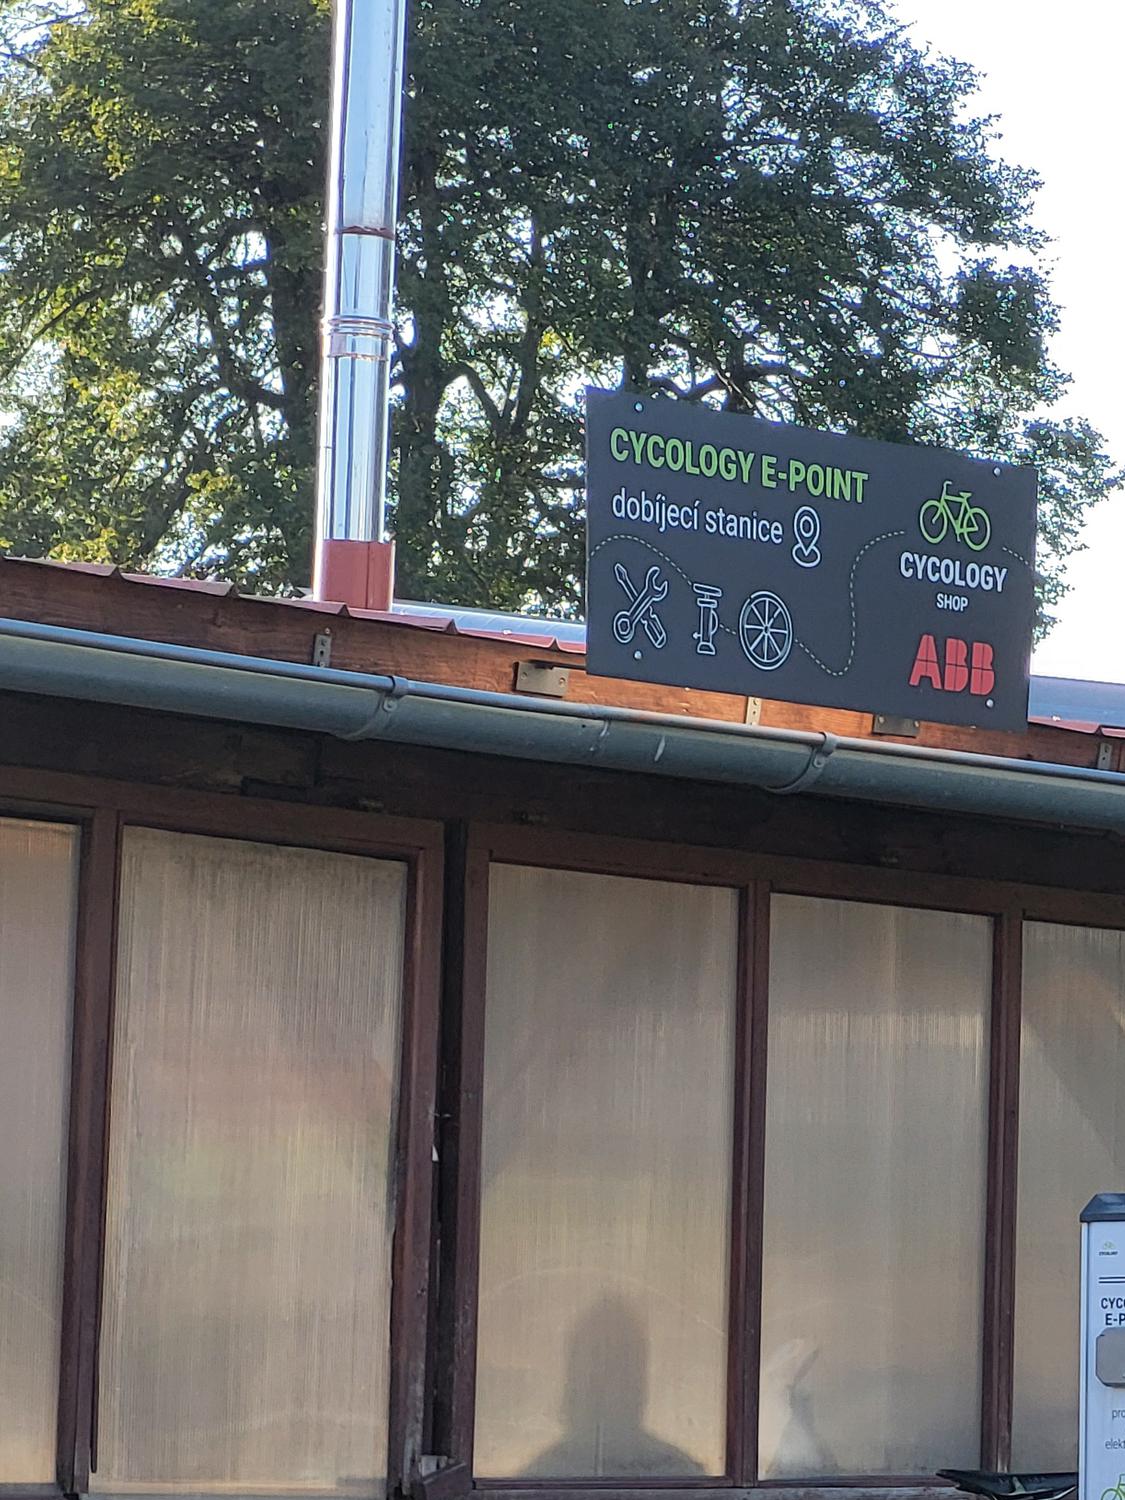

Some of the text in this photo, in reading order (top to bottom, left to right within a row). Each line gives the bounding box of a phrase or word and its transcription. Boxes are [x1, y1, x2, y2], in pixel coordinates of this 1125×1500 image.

[609, 427, 869, 503] CYCOLOGY E-POINT
[612, 487, 784, 544] dobíjecí stanice
[900, 551, 1008, 593] CYCOLOGY
[936, 592, 968, 612] SHOP
[908, 634, 995, 696] ABB
[1111, 1409, 1125, 1420] pro
